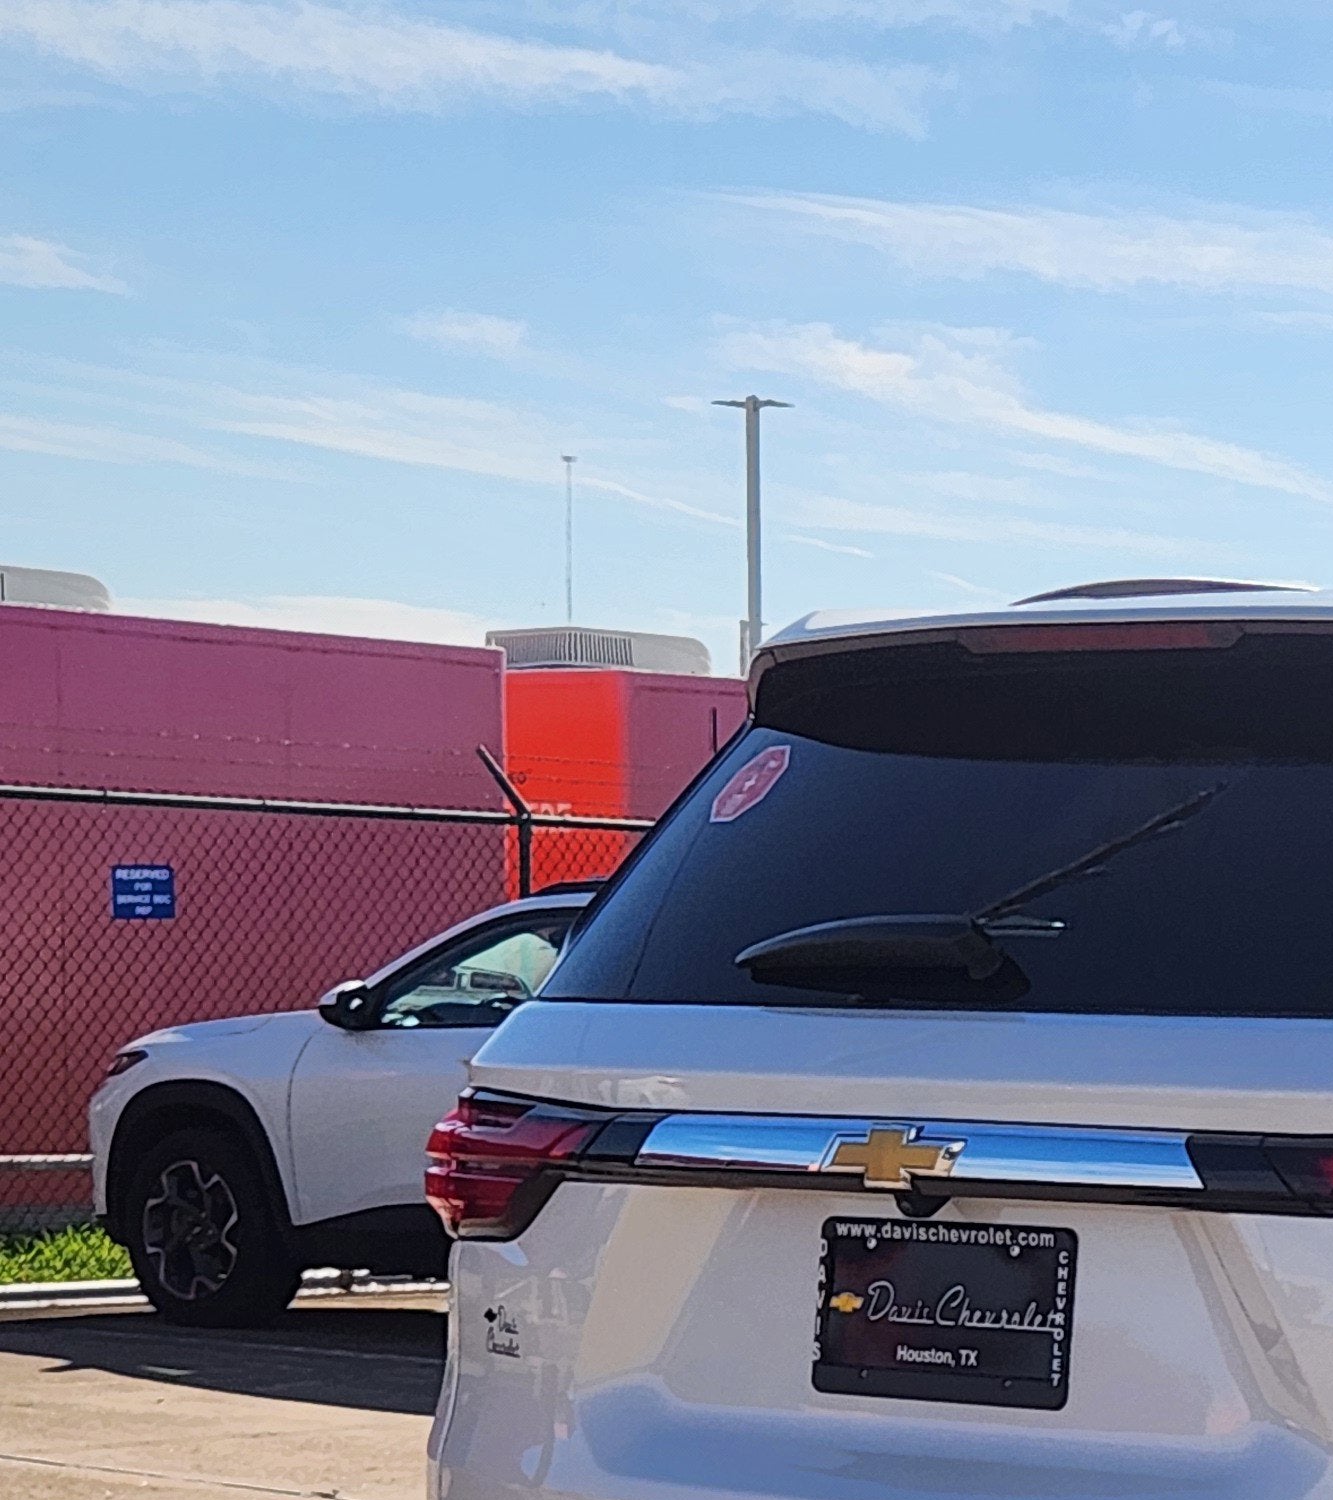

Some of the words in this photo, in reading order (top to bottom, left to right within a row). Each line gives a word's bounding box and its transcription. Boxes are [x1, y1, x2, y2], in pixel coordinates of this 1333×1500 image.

[835, 1221, 1055, 1248] www.davischevrolet.com
[867, 1280, 935, 1326] Davis
[935, 1285, 1058, 1333] Chevrolet
[1050, 1250, 1070, 1388] CHEVROLET
[896, 1344, 956, 1368] Houston,
[958, 1349, 979, 1367] TX
